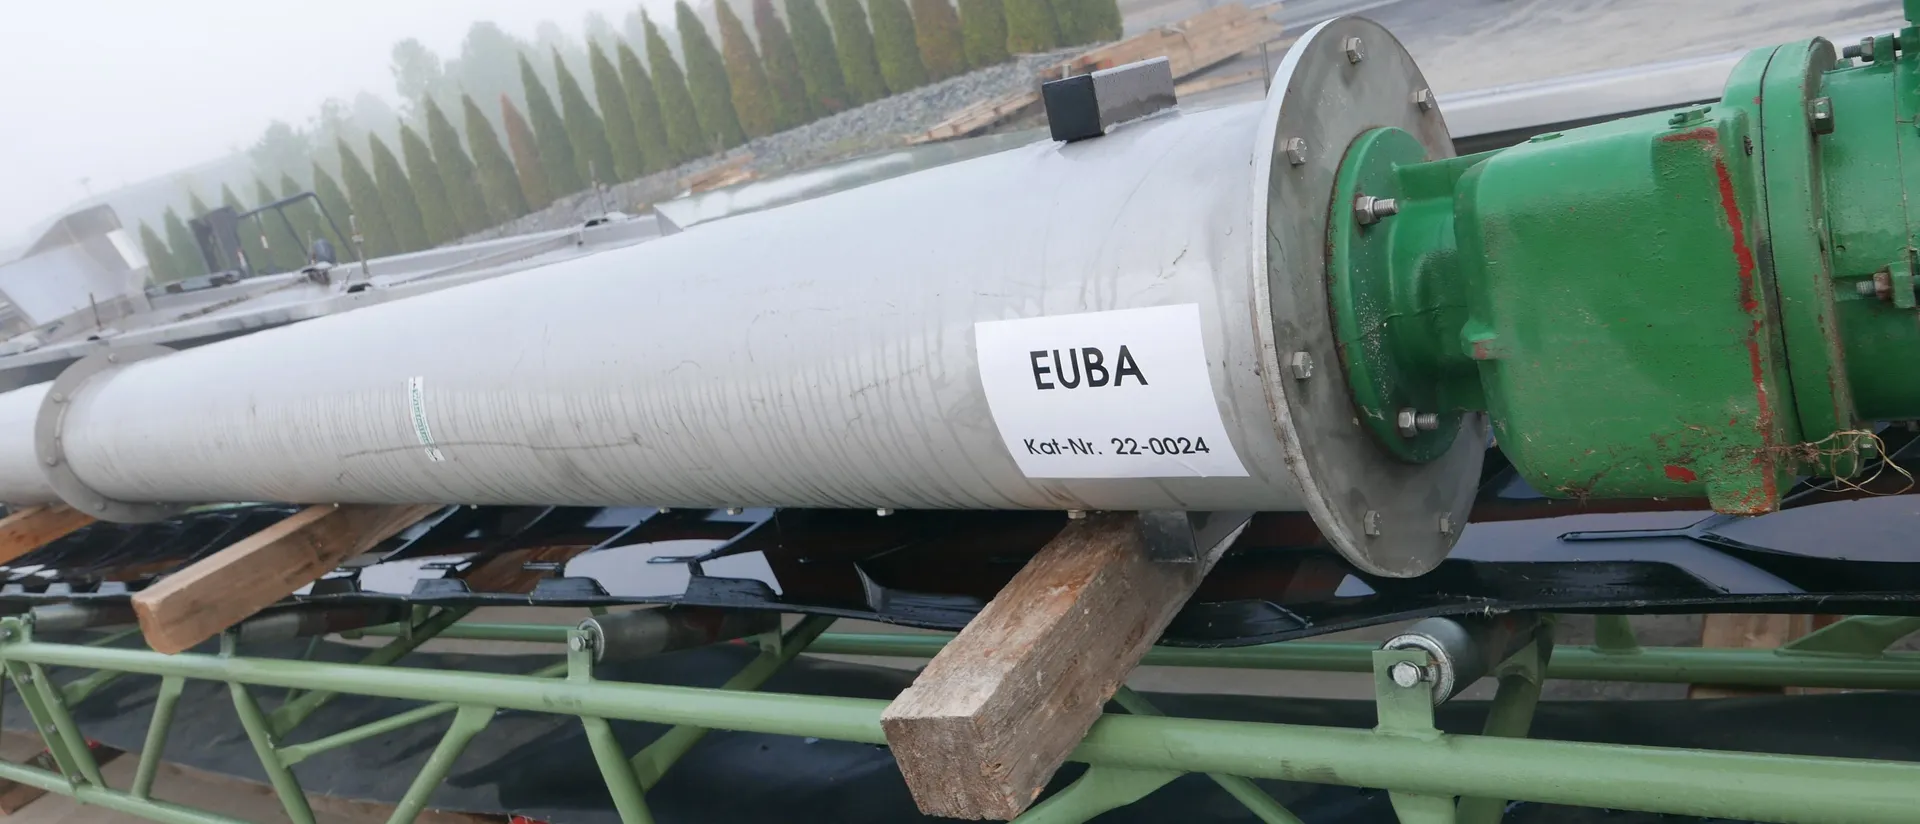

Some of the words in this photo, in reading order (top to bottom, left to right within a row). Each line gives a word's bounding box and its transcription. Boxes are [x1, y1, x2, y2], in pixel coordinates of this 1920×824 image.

[1029, 344, 1149, 390] EUBA
[1023, 438, 1103, 455] Kat-Nr.
[1110, 436, 1210, 456] 22-0024
